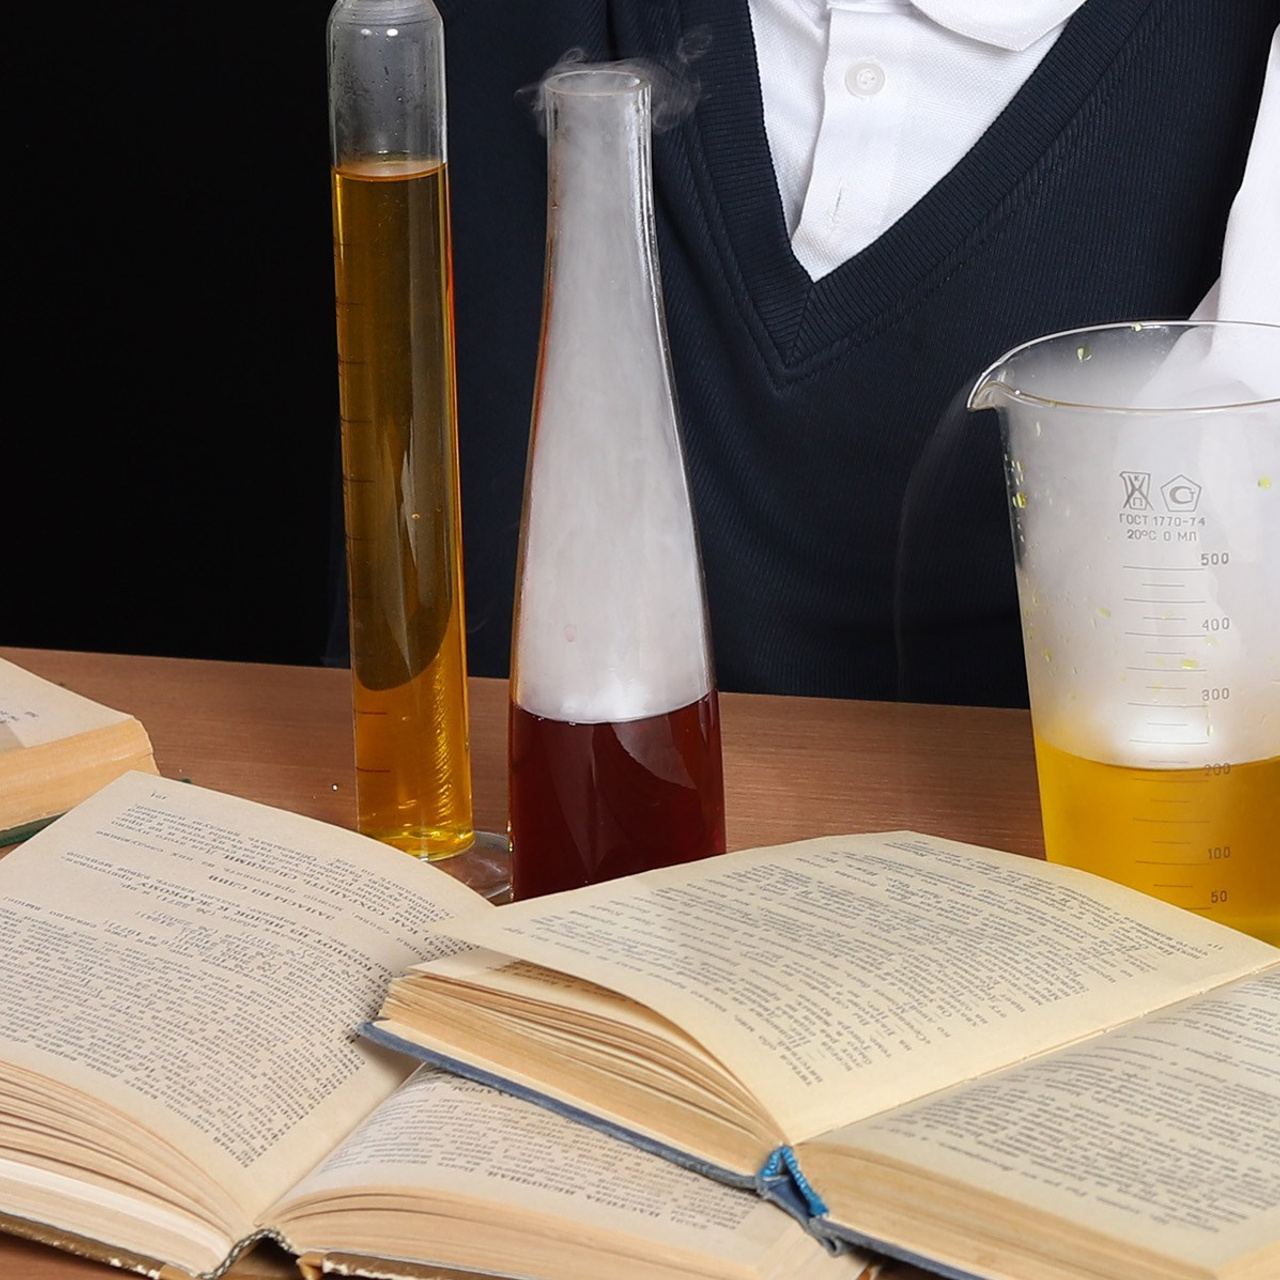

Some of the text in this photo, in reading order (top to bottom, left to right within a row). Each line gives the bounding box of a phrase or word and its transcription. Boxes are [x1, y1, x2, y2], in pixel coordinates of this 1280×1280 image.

[1119, 513, 1206, 527] ГОСТ 1770-74
[1177, 530, 1197, 542] МЛ
[1200, 552, 1230, 566] 500
[1201, 617, 1231, 632] 400
[1201, 687, 1231, 702] 300
[1203, 762, 1232, 778] 200
[1207, 845, 1232, 860] 100
[1210, 890, 1228, 904] 50
